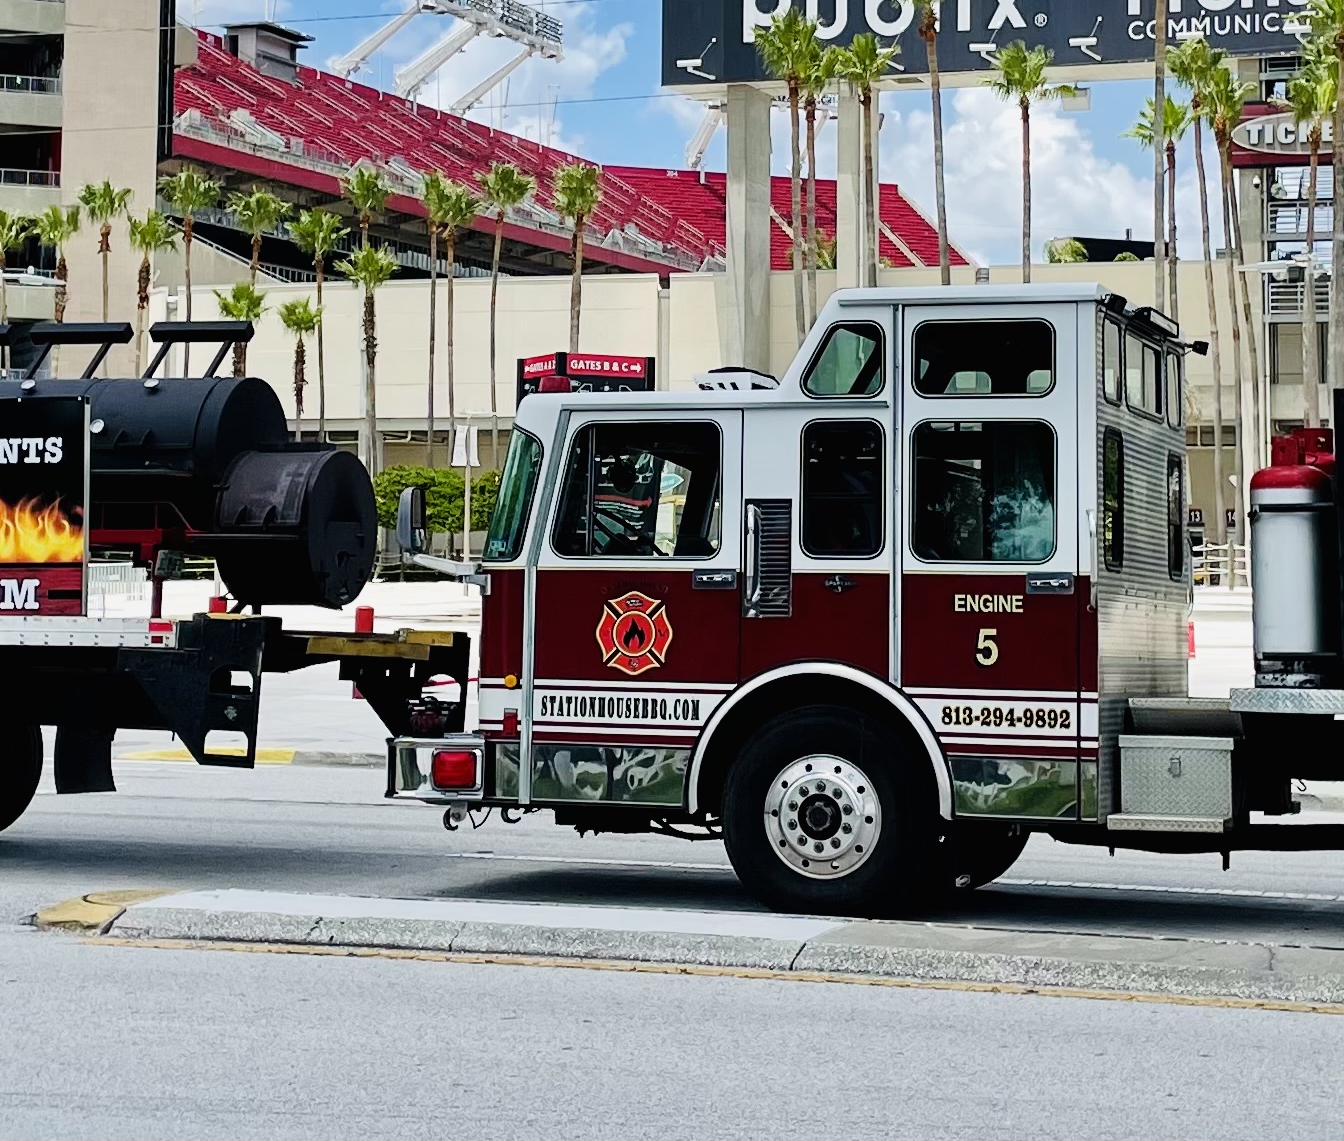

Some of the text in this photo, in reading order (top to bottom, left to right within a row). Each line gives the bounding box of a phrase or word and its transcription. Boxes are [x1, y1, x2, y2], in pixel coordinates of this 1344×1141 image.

[570, 360, 601, 371] GATES
[611, 362, 619, 371] &
[1191, 511, 1200, 522] 13
[954, 594, 1024, 613] ENGINE
[975, 628, 999, 666] 5
[541, 695, 700, 721] STATIONHOUSEBBQ.COM
[941, 706, 1071, 729] 813-294-9892
